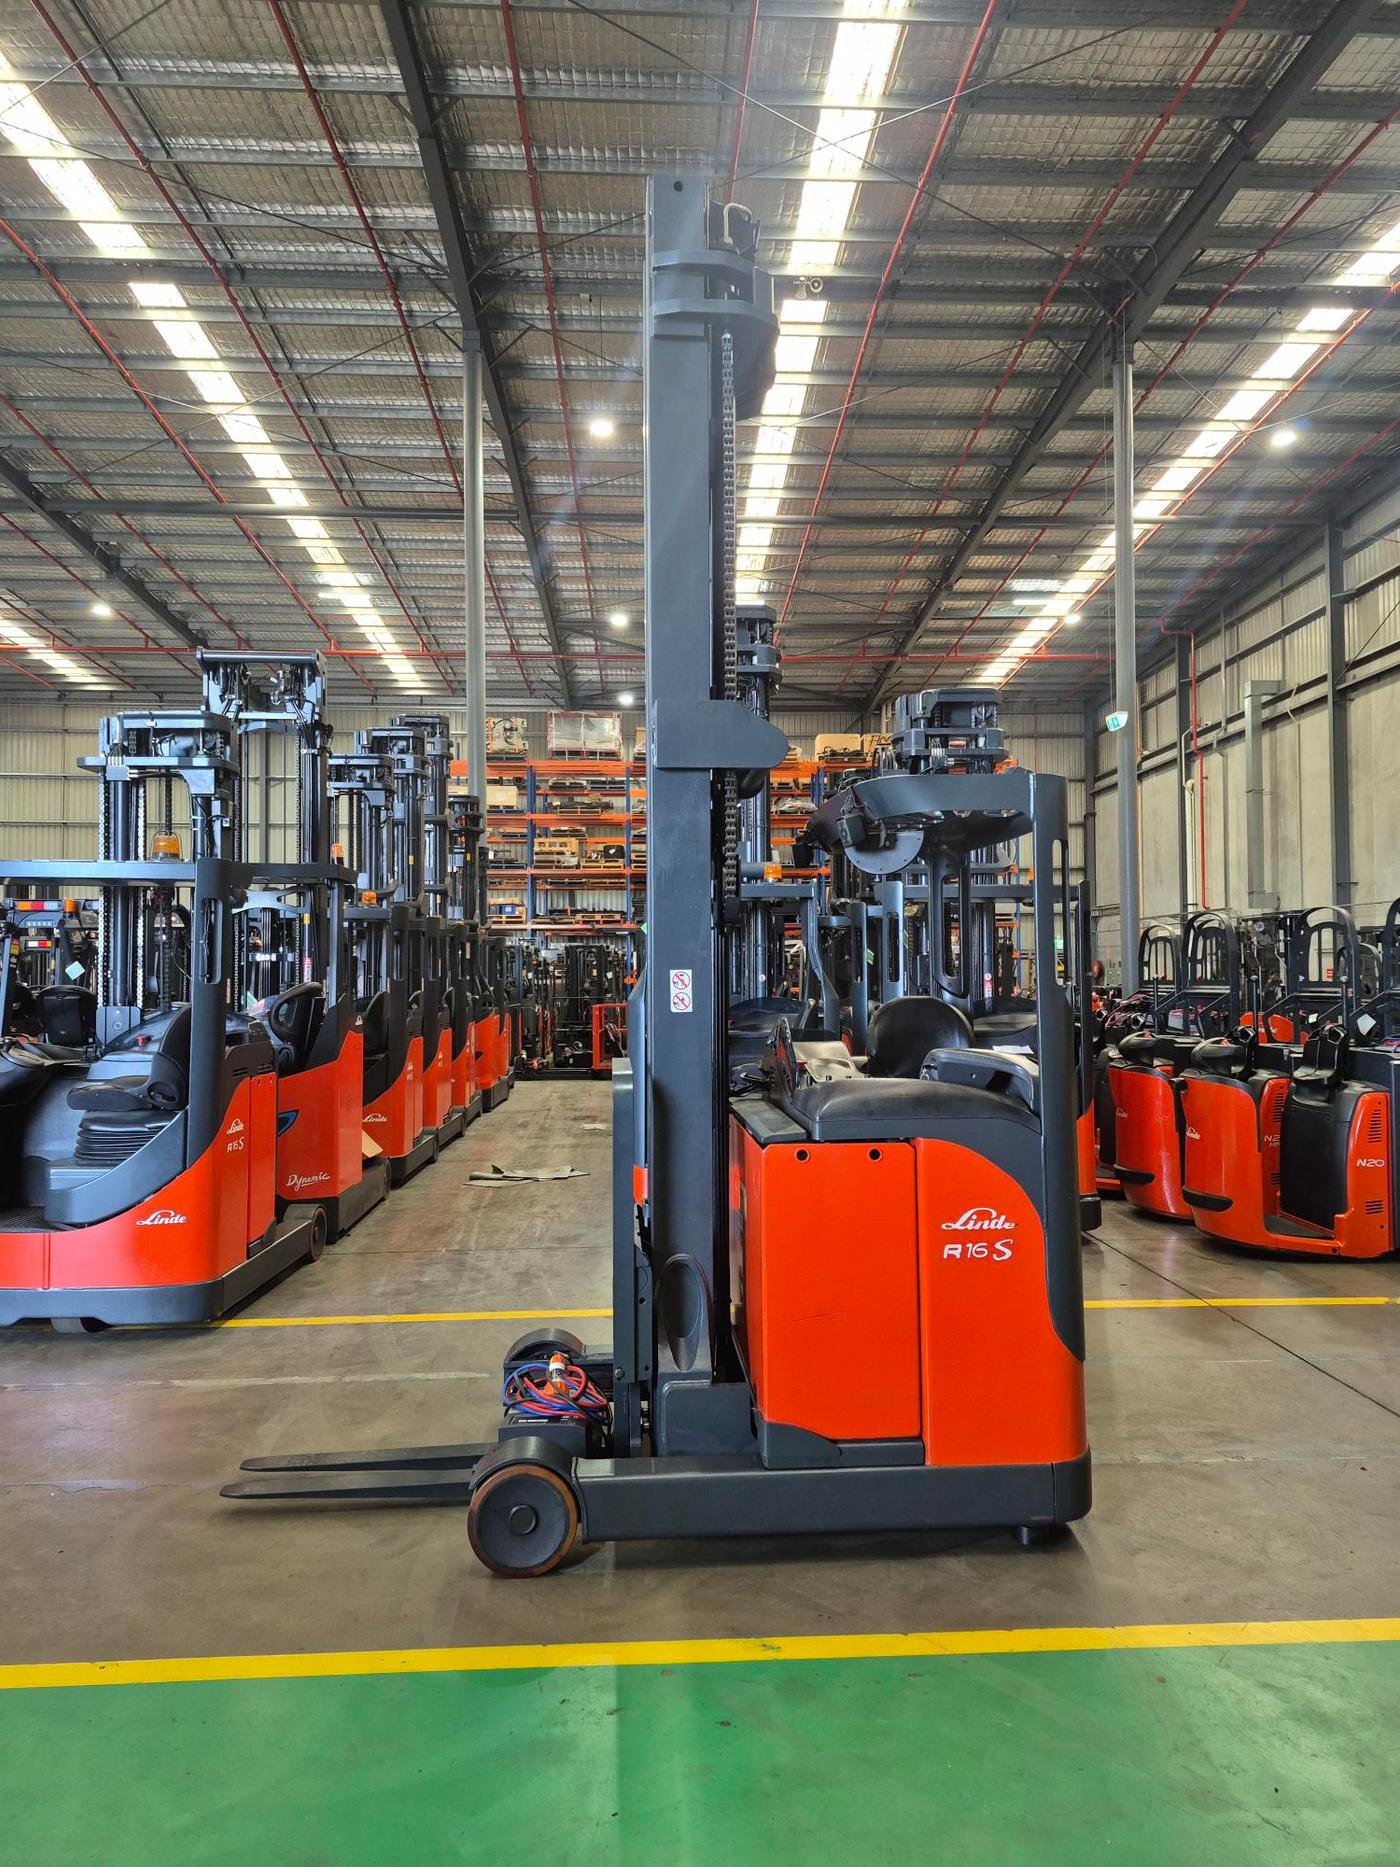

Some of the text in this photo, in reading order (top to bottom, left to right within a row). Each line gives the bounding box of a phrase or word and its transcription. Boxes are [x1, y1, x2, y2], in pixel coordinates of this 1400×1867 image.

[362, 1113, 388, 1122] Linde
[1263, 1134, 1280, 1142] N2
[1356, 1159, 1385, 1167] N20
[286, 1171, 331, 1191] Dynamic
[136, 1210, 187, 1226] Linde
[941, 1207, 1015, 1230] Linde
